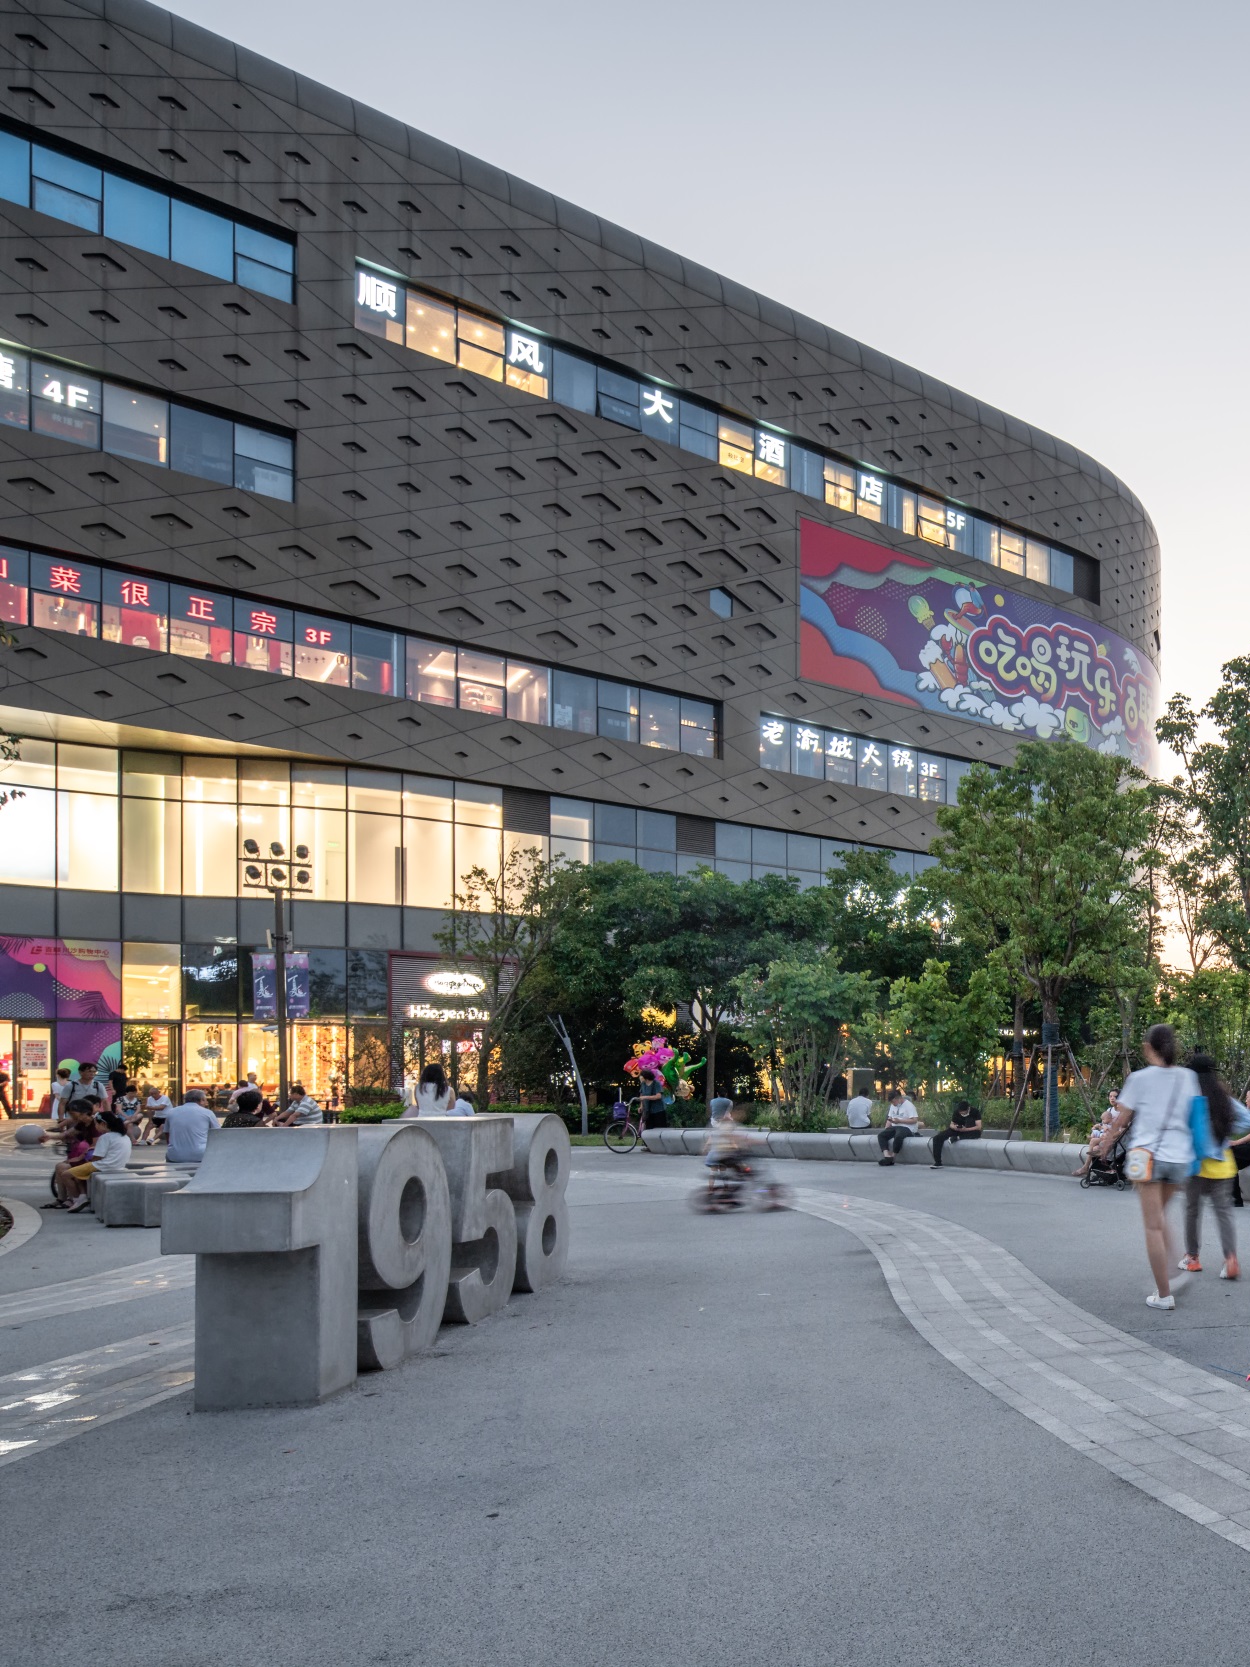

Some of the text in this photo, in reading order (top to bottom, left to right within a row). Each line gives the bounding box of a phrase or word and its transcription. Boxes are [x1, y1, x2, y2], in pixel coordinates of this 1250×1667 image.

[42, 380, 89, 408] 4F
[357, 272, 966, 531] 顺风大酒店 5F
[0, 557, 333, 646] 菜很正宗 3F
[978, 628, 1117, 717] 吃喝玩乐
[762, 720, 938, 777] 老渝城火锅 3F
[161, 1112, 571, 1412] 1958
